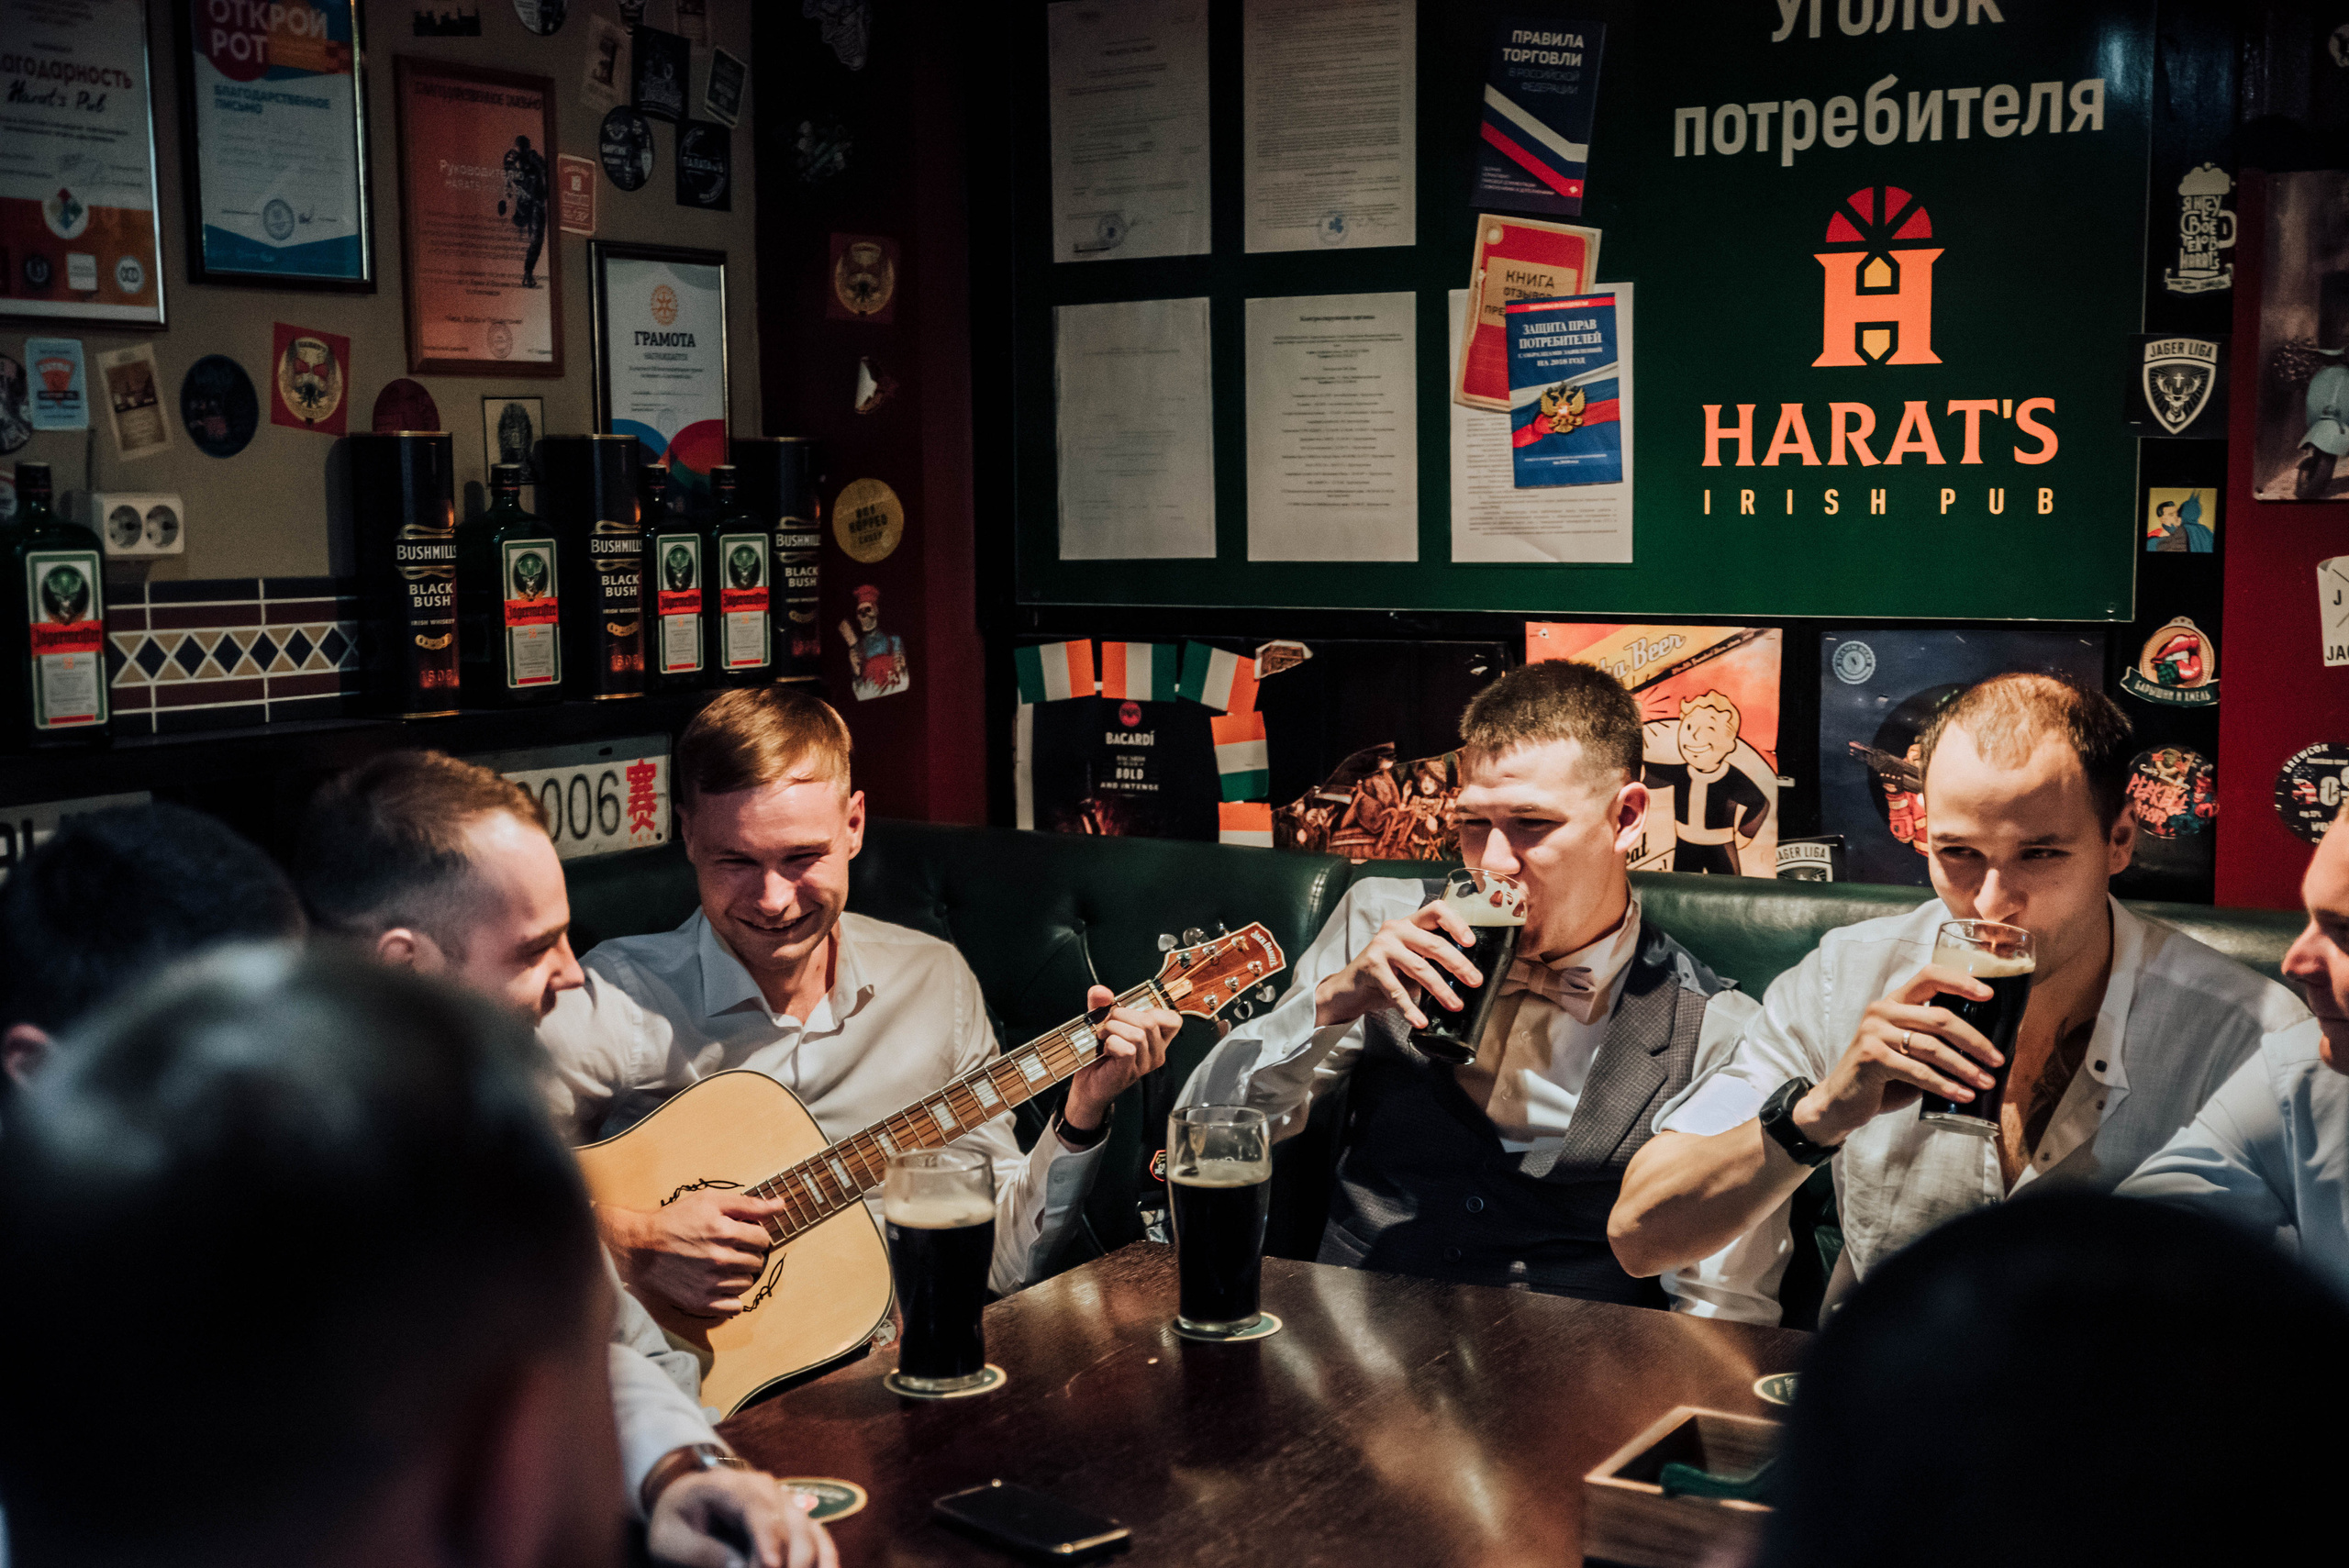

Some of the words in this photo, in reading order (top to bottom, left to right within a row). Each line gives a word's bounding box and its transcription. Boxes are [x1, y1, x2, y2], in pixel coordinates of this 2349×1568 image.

[208, 0, 328, 39] ОТКРОЙ
[211, 28, 268, 63] РОТ
[1511, 29, 1585, 49] ПРАВИЛА
[1502, 48, 1583, 67] ТОРГОВЛИ
[0, 53, 132, 90] агодарность
[1520, 82, 1578, 95] ФЕДЕРАЦИИ
[1674, 73, 2107, 167] потребителя
[1506, 270, 1554, 288] КНИГА
[1485, 305, 1506, 317] ПРЕ
[1522, 322, 1566, 335] ЗАЩИТА
[1568, 319, 1598, 331] ПРАВ
[634, 330, 696, 348] ГРАМОТА
[1519, 331, 1603, 350] ПОТРЕБИТЕЛЕЙ
[2150, 342, 2185, 357] JAGER
[2188, 343, 2212, 359] LIGA
[1569, 357, 1586, 365] ГОД
[1701, 396, 2060, 467] HARAT'S
[1703, 488, 1887, 516] IRISH
[1940, 487, 2054, 515] PUB
[785, 566, 818, 577] BLACK
[601, 574, 640, 586] BLACK
[788, 577, 817, 588] BUSH
[408, 583, 453, 595] BLACK
[605, 586, 637, 597] BUSH
[413, 595, 451, 607] BUSH
[2333, 589, 2342, 606] J
[1624, 634, 1686, 671] Beer
[2326, 645, 2349, 661] JA
[2176, 691, 2182, 701] И
[2184, 690, 2211, 701] ХМЕЛЬ
[1105, 729, 1155, 746] BACARDÍ
[1116, 767, 1144, 780] BOLD
[1099, 782, 1119, 790] AND
[1120, 783, 1159, 792] INTENSE
[516, 770, 621, 843] 006
[1805, 846, 1825, 859] LIGA
[1250, 930, 1267, 945] JACK
